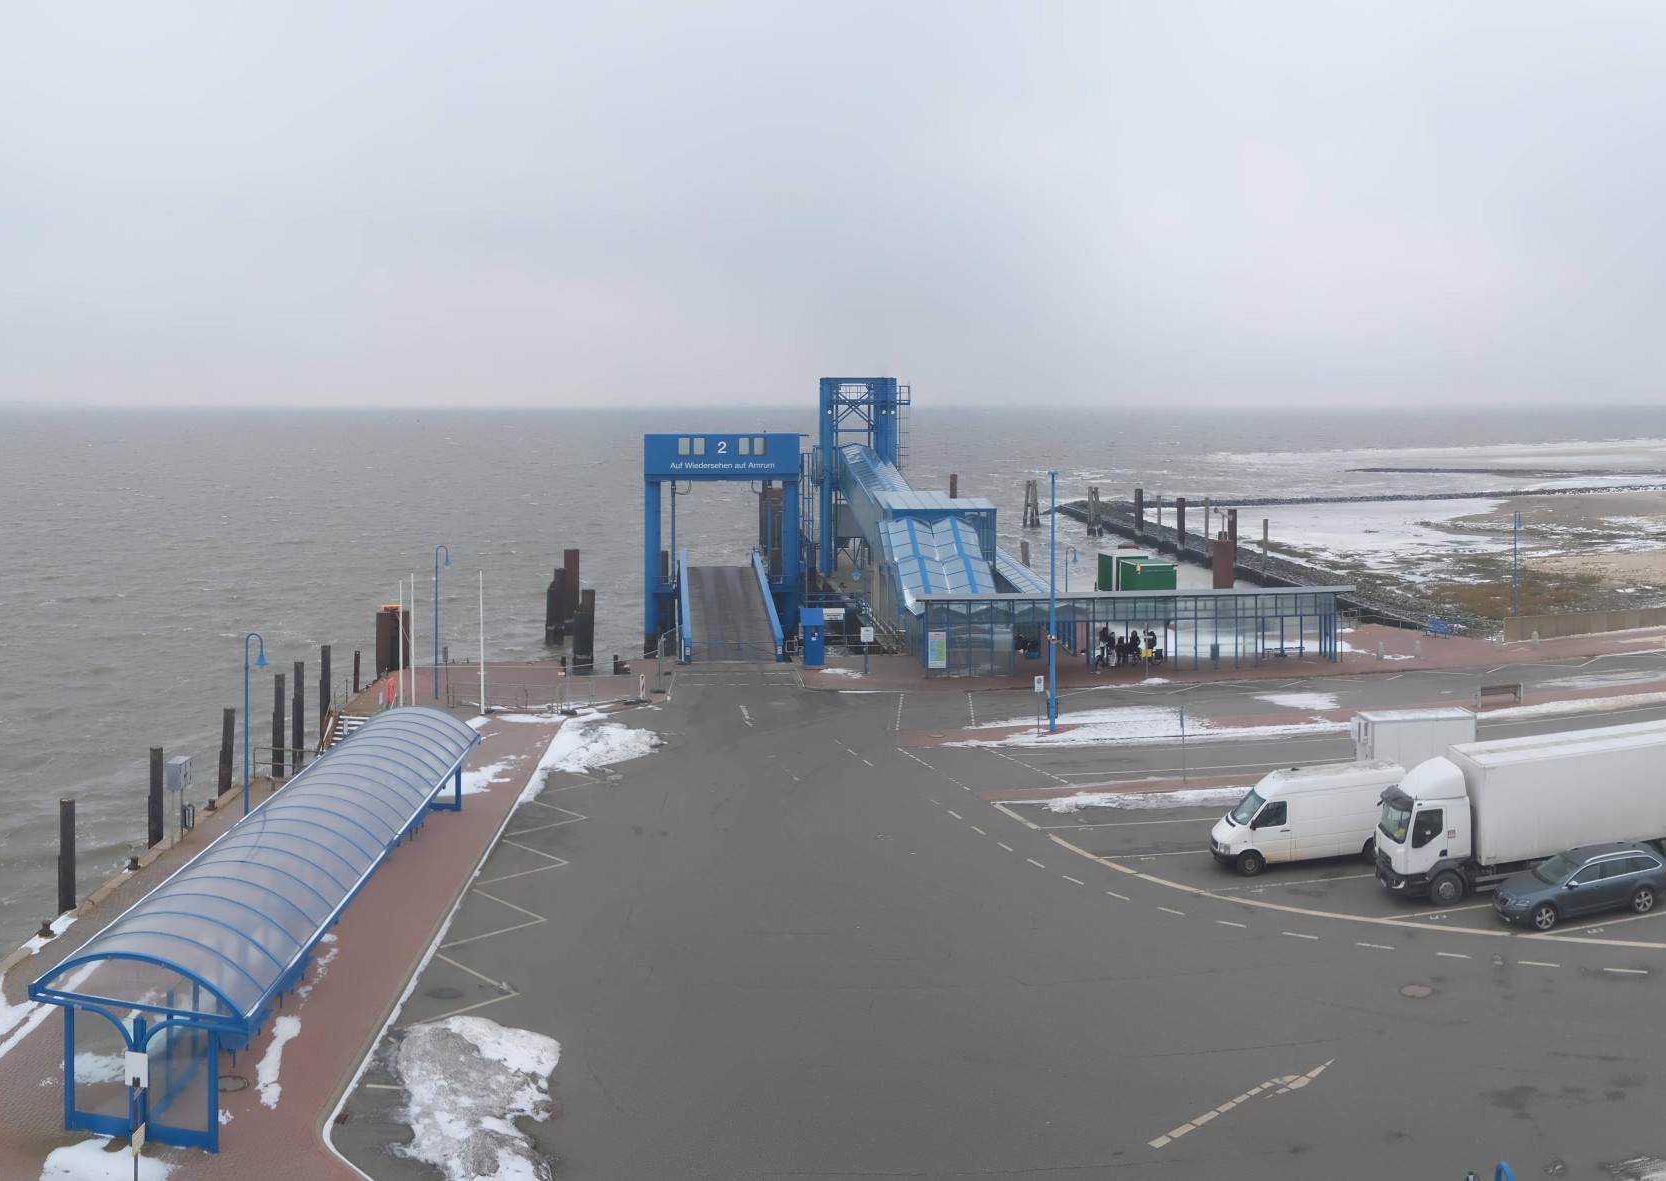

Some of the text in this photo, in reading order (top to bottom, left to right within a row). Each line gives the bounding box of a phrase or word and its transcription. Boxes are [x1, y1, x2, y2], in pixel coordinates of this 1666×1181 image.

[717, 441, 727, 454] 2
[669, 461, 683, 469] Auf
[684, 461, 733, 469] Wiedersehen
[734, 461, 747, 469] auf
